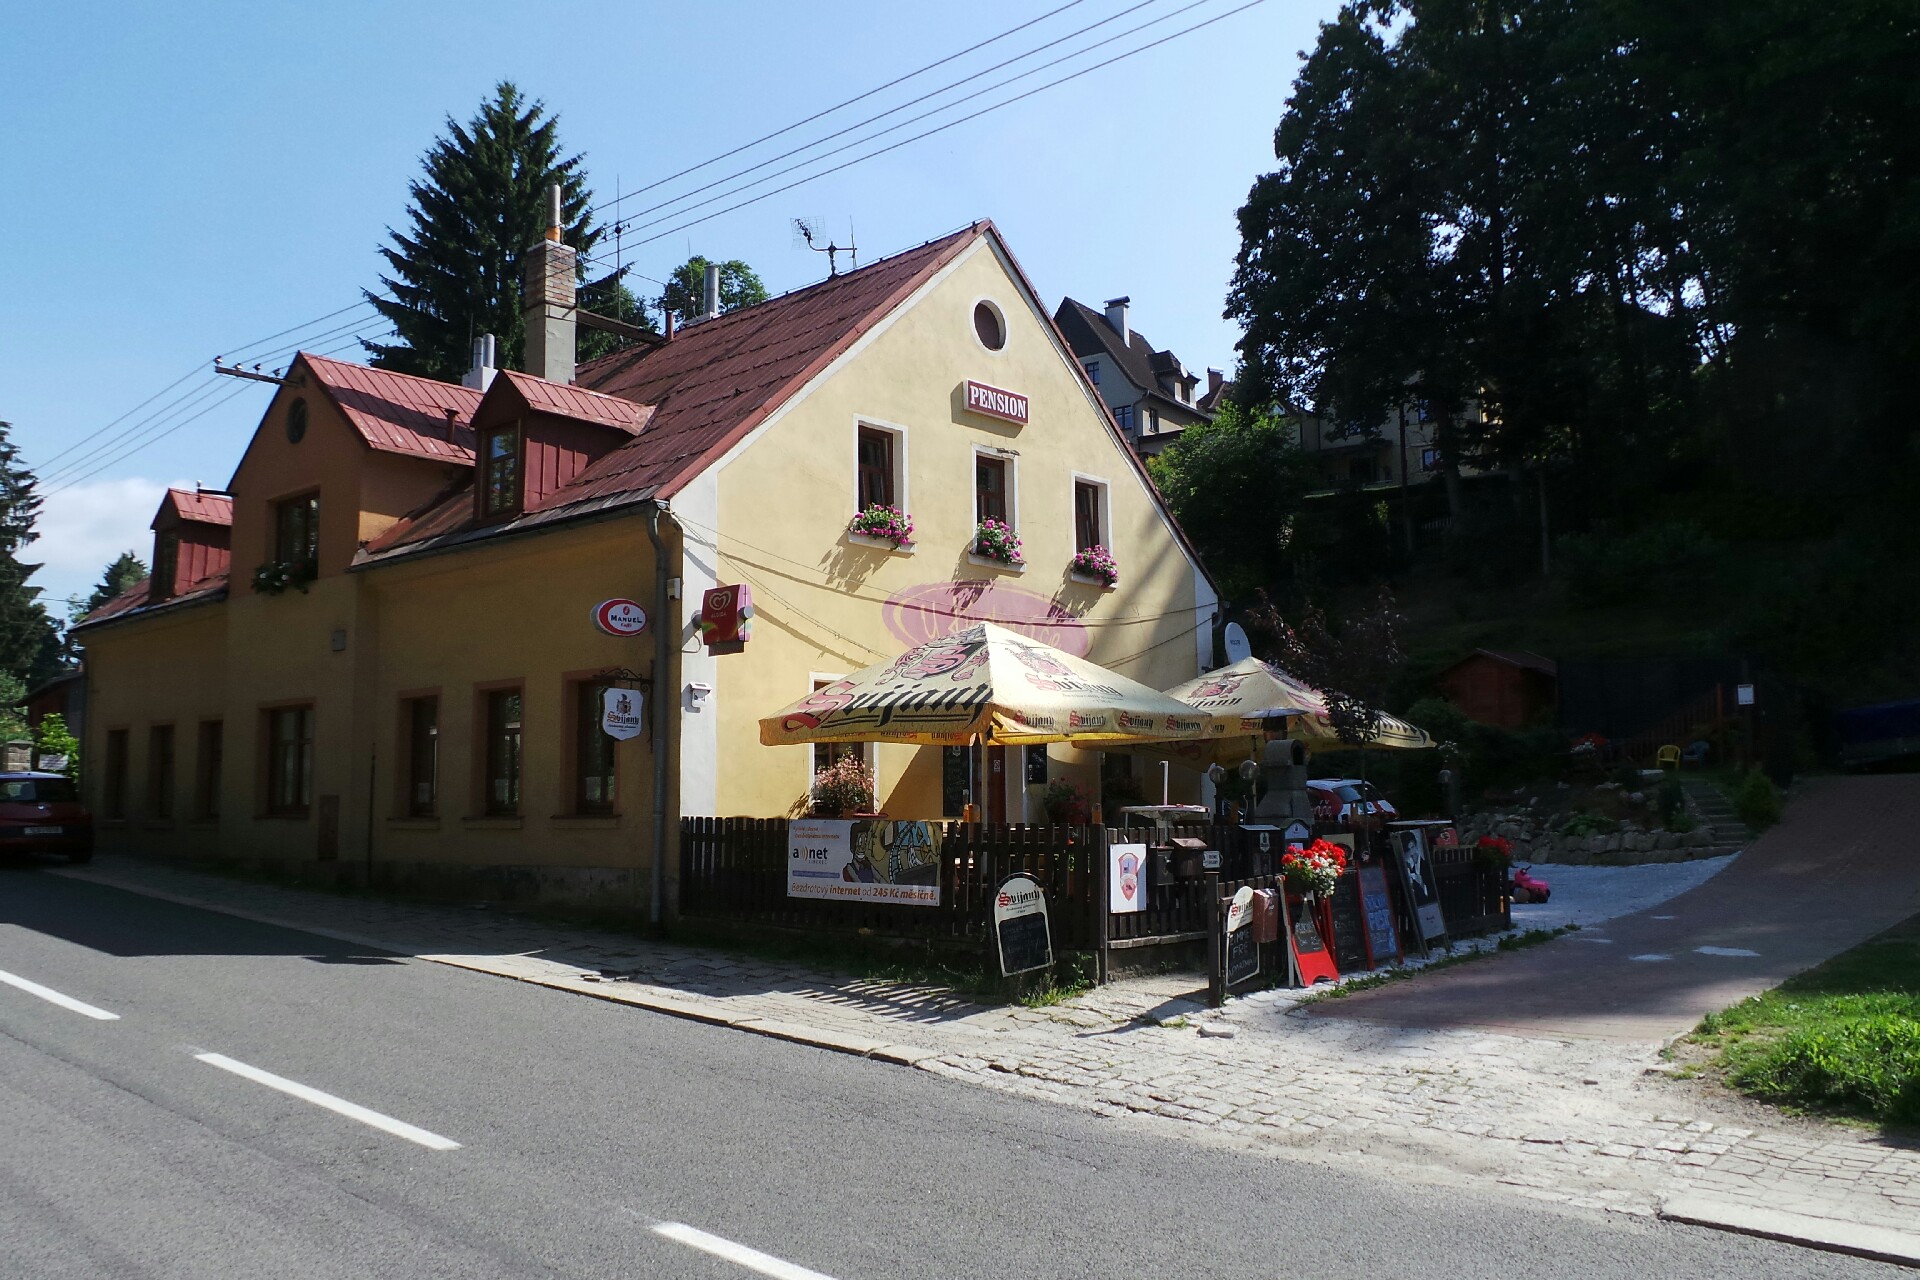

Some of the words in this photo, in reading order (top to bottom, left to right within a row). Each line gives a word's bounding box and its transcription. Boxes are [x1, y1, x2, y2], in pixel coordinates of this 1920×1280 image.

[969, 384, 1027, 420] PENSION
[611, 615, 643, 624] MANUEL
[781, 681, 993, 732] Svijany
[607, 711, 639, 725] Svijany
[1013, 710, 1055, 727] Svijany
[1070, 710, 1107, 727] Svijany
[1119, 710, 1153, 729] Svijany
[1165, 714, 1202, 731] Svijany
[830, 885, 861, 896] internet
[862, 887, 872, 896] od
[873, 887, 888, 897] 245
[889, 887, 899, 898] Kč
[900, 888, 936, 900] měsíčně.
[998, 890, 1040, 908] Svijany
